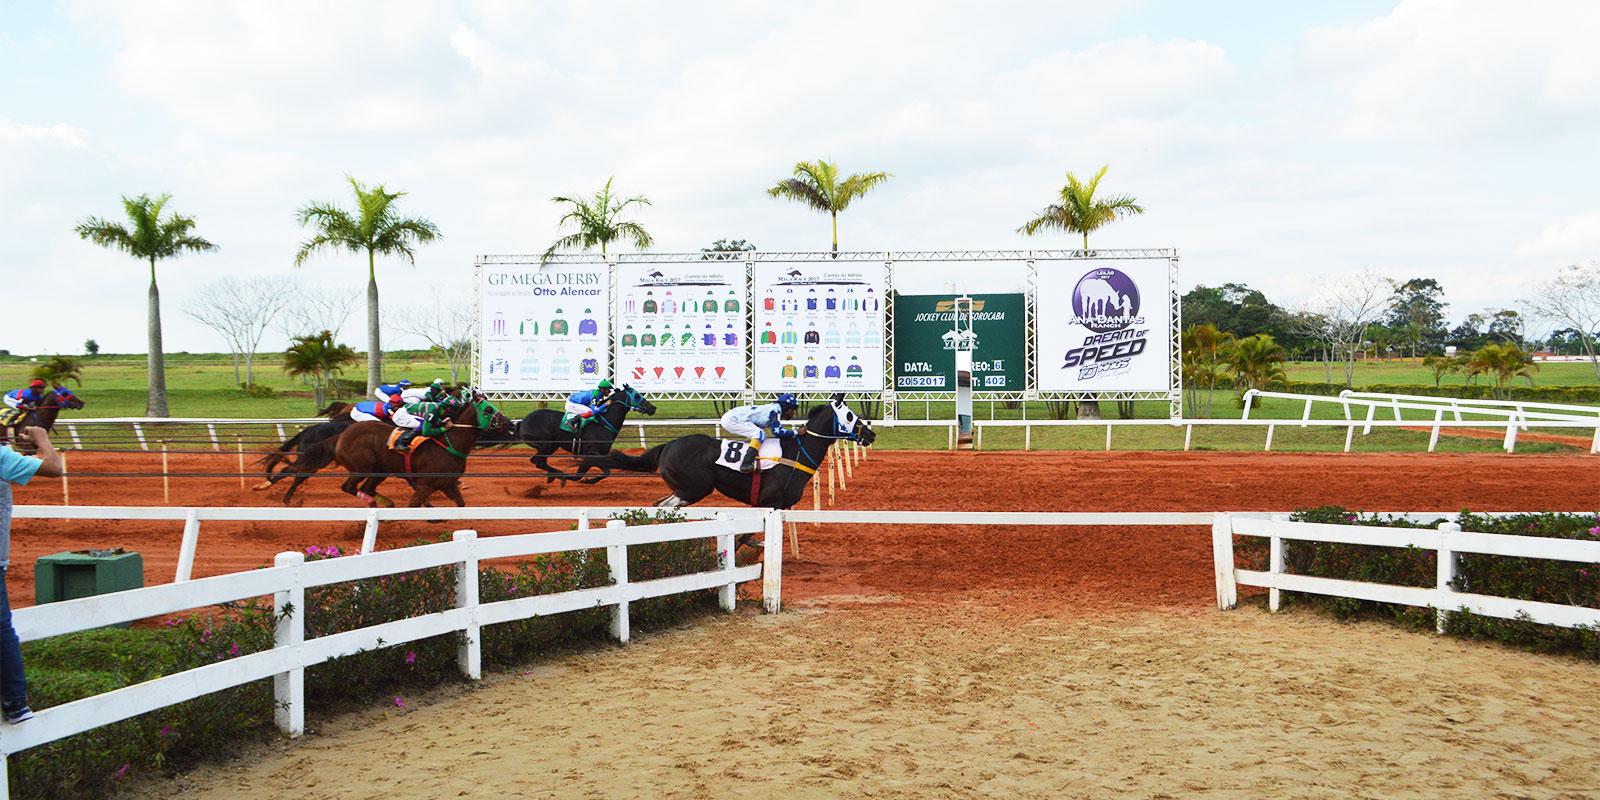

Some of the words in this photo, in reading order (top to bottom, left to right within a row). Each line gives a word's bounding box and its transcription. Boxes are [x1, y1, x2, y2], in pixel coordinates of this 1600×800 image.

[488, 273, 508, 285] GP
[511, 273, 552, 285] MEGA
[556, 272, 602, 285] DERBY
[533, 287, 556, 296] Otto
[560, 286, 602, 296] Alencar
[915, 312, 940, 322] JOCKEY
[1098, 315, 1145, 325] DANTAS
[1083, 328, 1135, 346] DREAM
[1135, 329, 1150, 338] OF
[1061, 338, 1147, 369] SPEED
[904, 362, 932, 372] DATA:
[994, 361, 1001, 370] 6
[985, 376, 1005, 385] 402
[724, 441, 744, 463] 8
